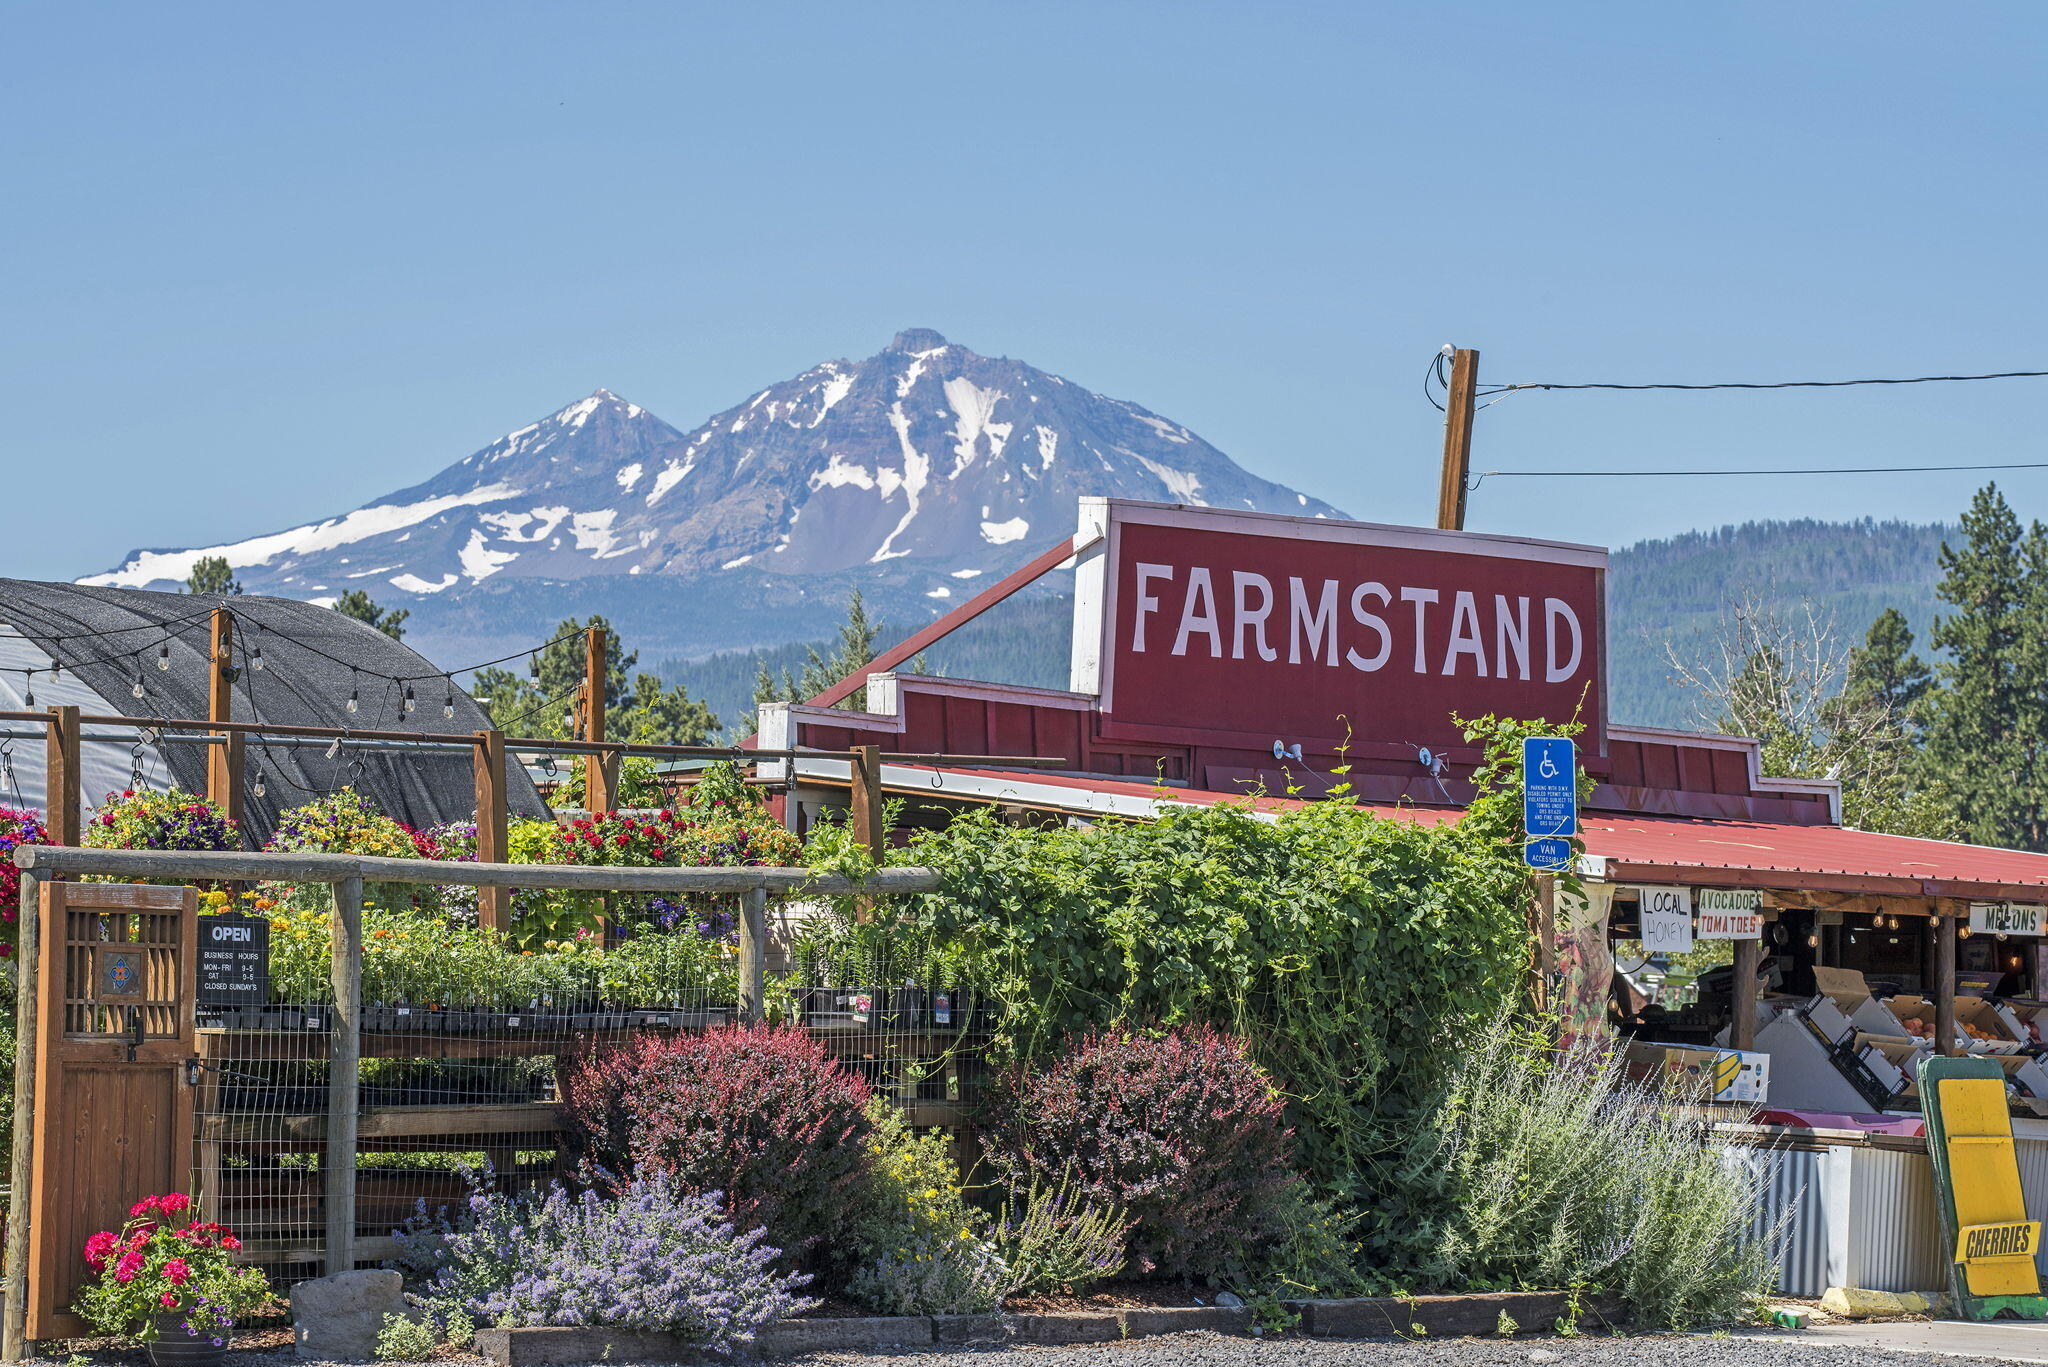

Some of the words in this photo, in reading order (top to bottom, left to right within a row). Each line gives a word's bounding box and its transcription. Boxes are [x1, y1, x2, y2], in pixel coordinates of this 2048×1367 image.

[1132, 562, 1582, 683] FARMSTAND
[1540, 844, 1556, 855] VAN
[1531, 854, 1563, 863] ACCESSIBLE
[1643, 889, 1687, 916] LOCAL
[1701, 915, 1756, 933] TOMATOES
[212, 926, 251, 941] OPEN
[1647, 919, 1685, 947] HONEY
[204, 951, 233, 959] BUSINESS
[238, 952, 259, 960] HOURS
[208, 972, 219, 980] SAT
[204, 982, 228, 990] CLOSED
[229, 983, 257, 991] SUNDAY'S
[1966, 1224, 2031, 1258] CHERRIES
